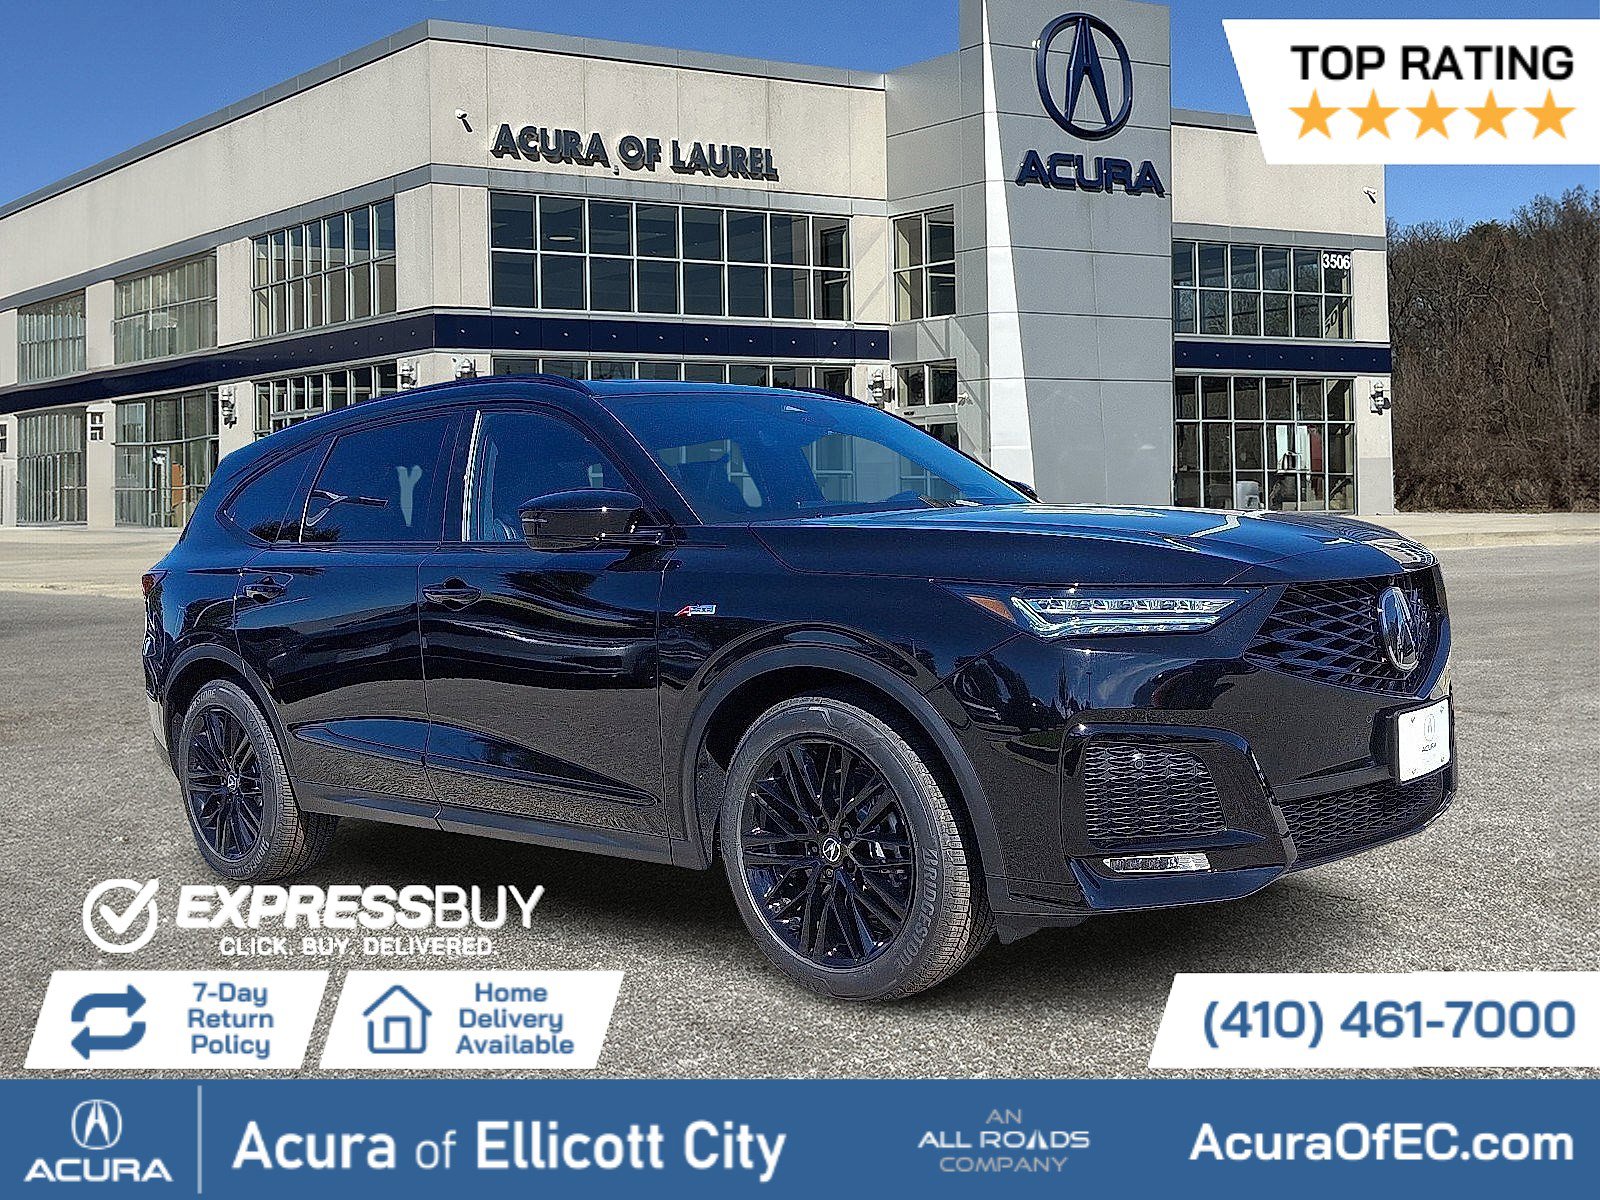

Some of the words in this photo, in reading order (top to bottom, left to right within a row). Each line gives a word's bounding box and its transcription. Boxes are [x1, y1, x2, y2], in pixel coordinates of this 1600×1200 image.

[491, 122, 609, 169] ACURA
[617, 135, 661, 172] OF
[672, 140, 780, 181] LAUREL
[1015, 148, 1165, 197] ACURA
[1322, 253, 1351, 270] 3506
